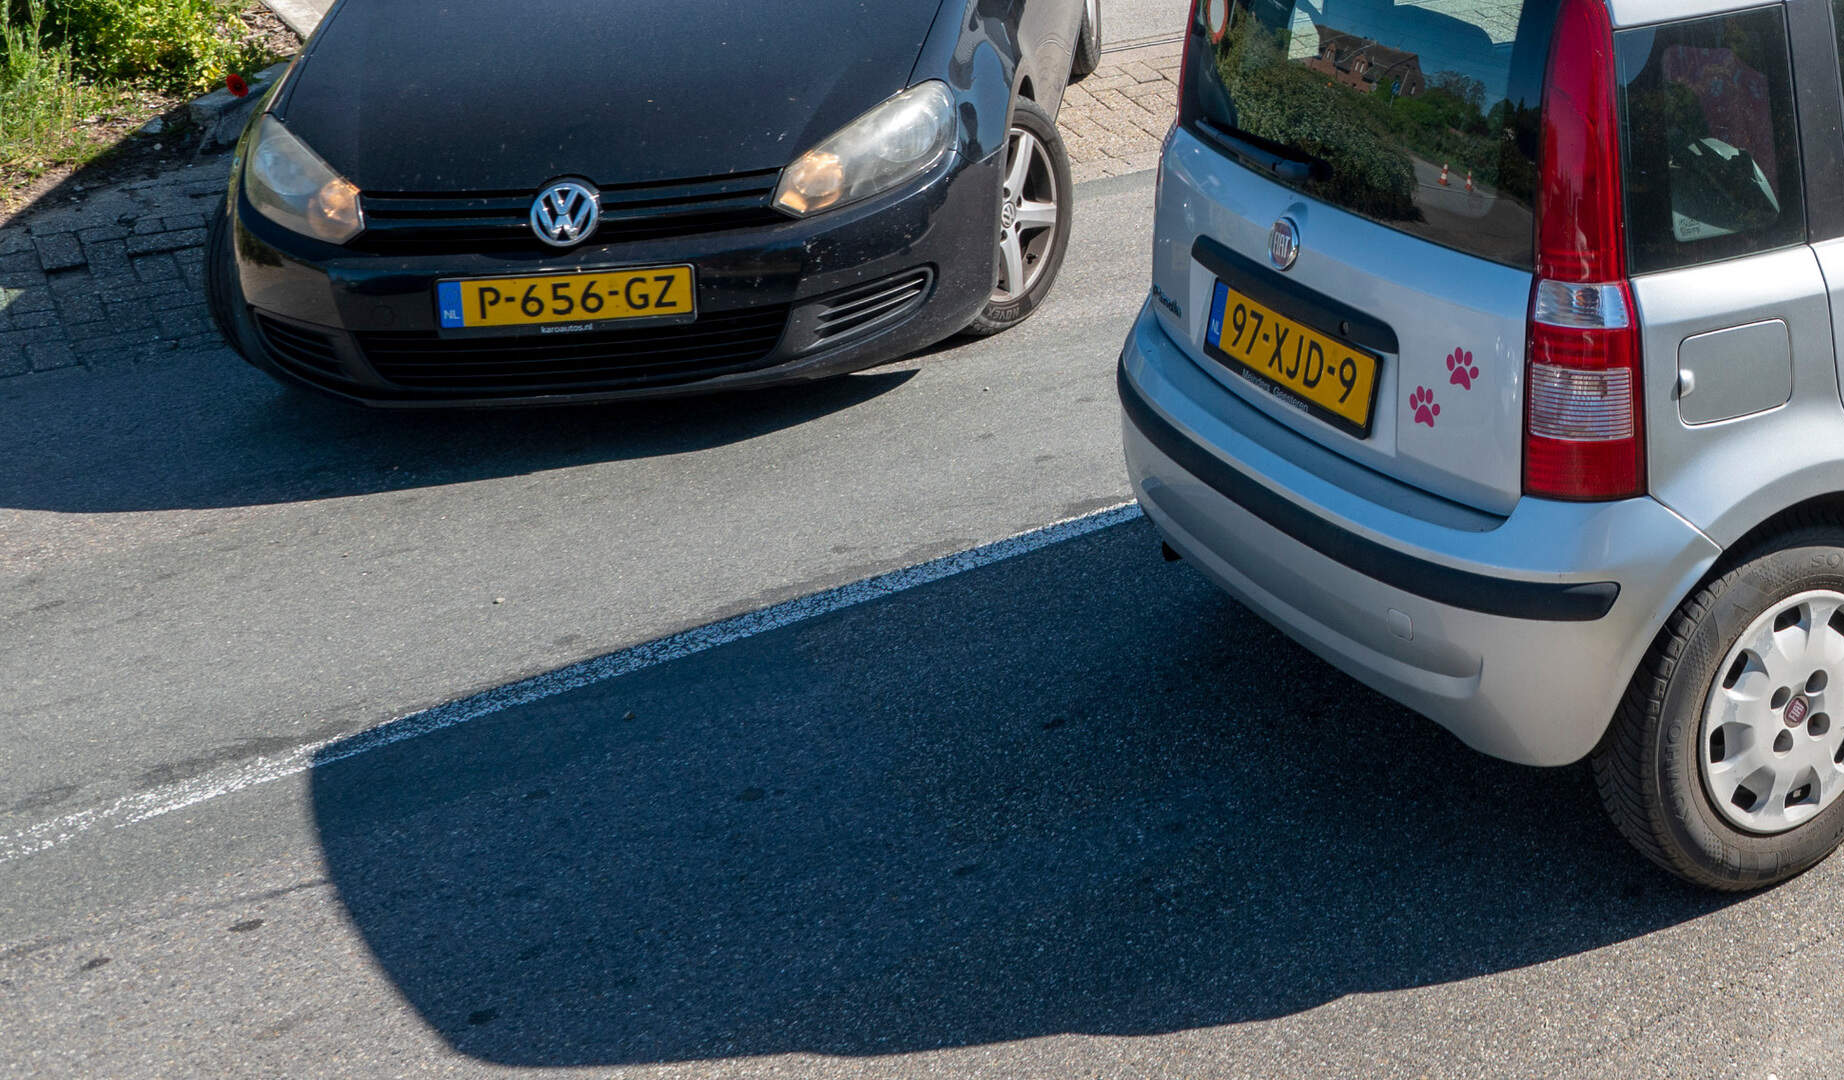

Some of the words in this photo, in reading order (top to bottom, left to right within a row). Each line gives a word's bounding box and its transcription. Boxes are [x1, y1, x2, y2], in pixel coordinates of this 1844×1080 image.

[1273, 231, 1291, 258] FIAT
[444, 309, 459, 319] NL
[478, 275, 677, 319] P-656-GZ
[540, 323, 594, 334] karoautos.nl
[1211, 319, 1220, 335] NL
[1231, 302, 1357, 404] 97-XJD-9
[1788, 700, 1805, 722] FIAT
